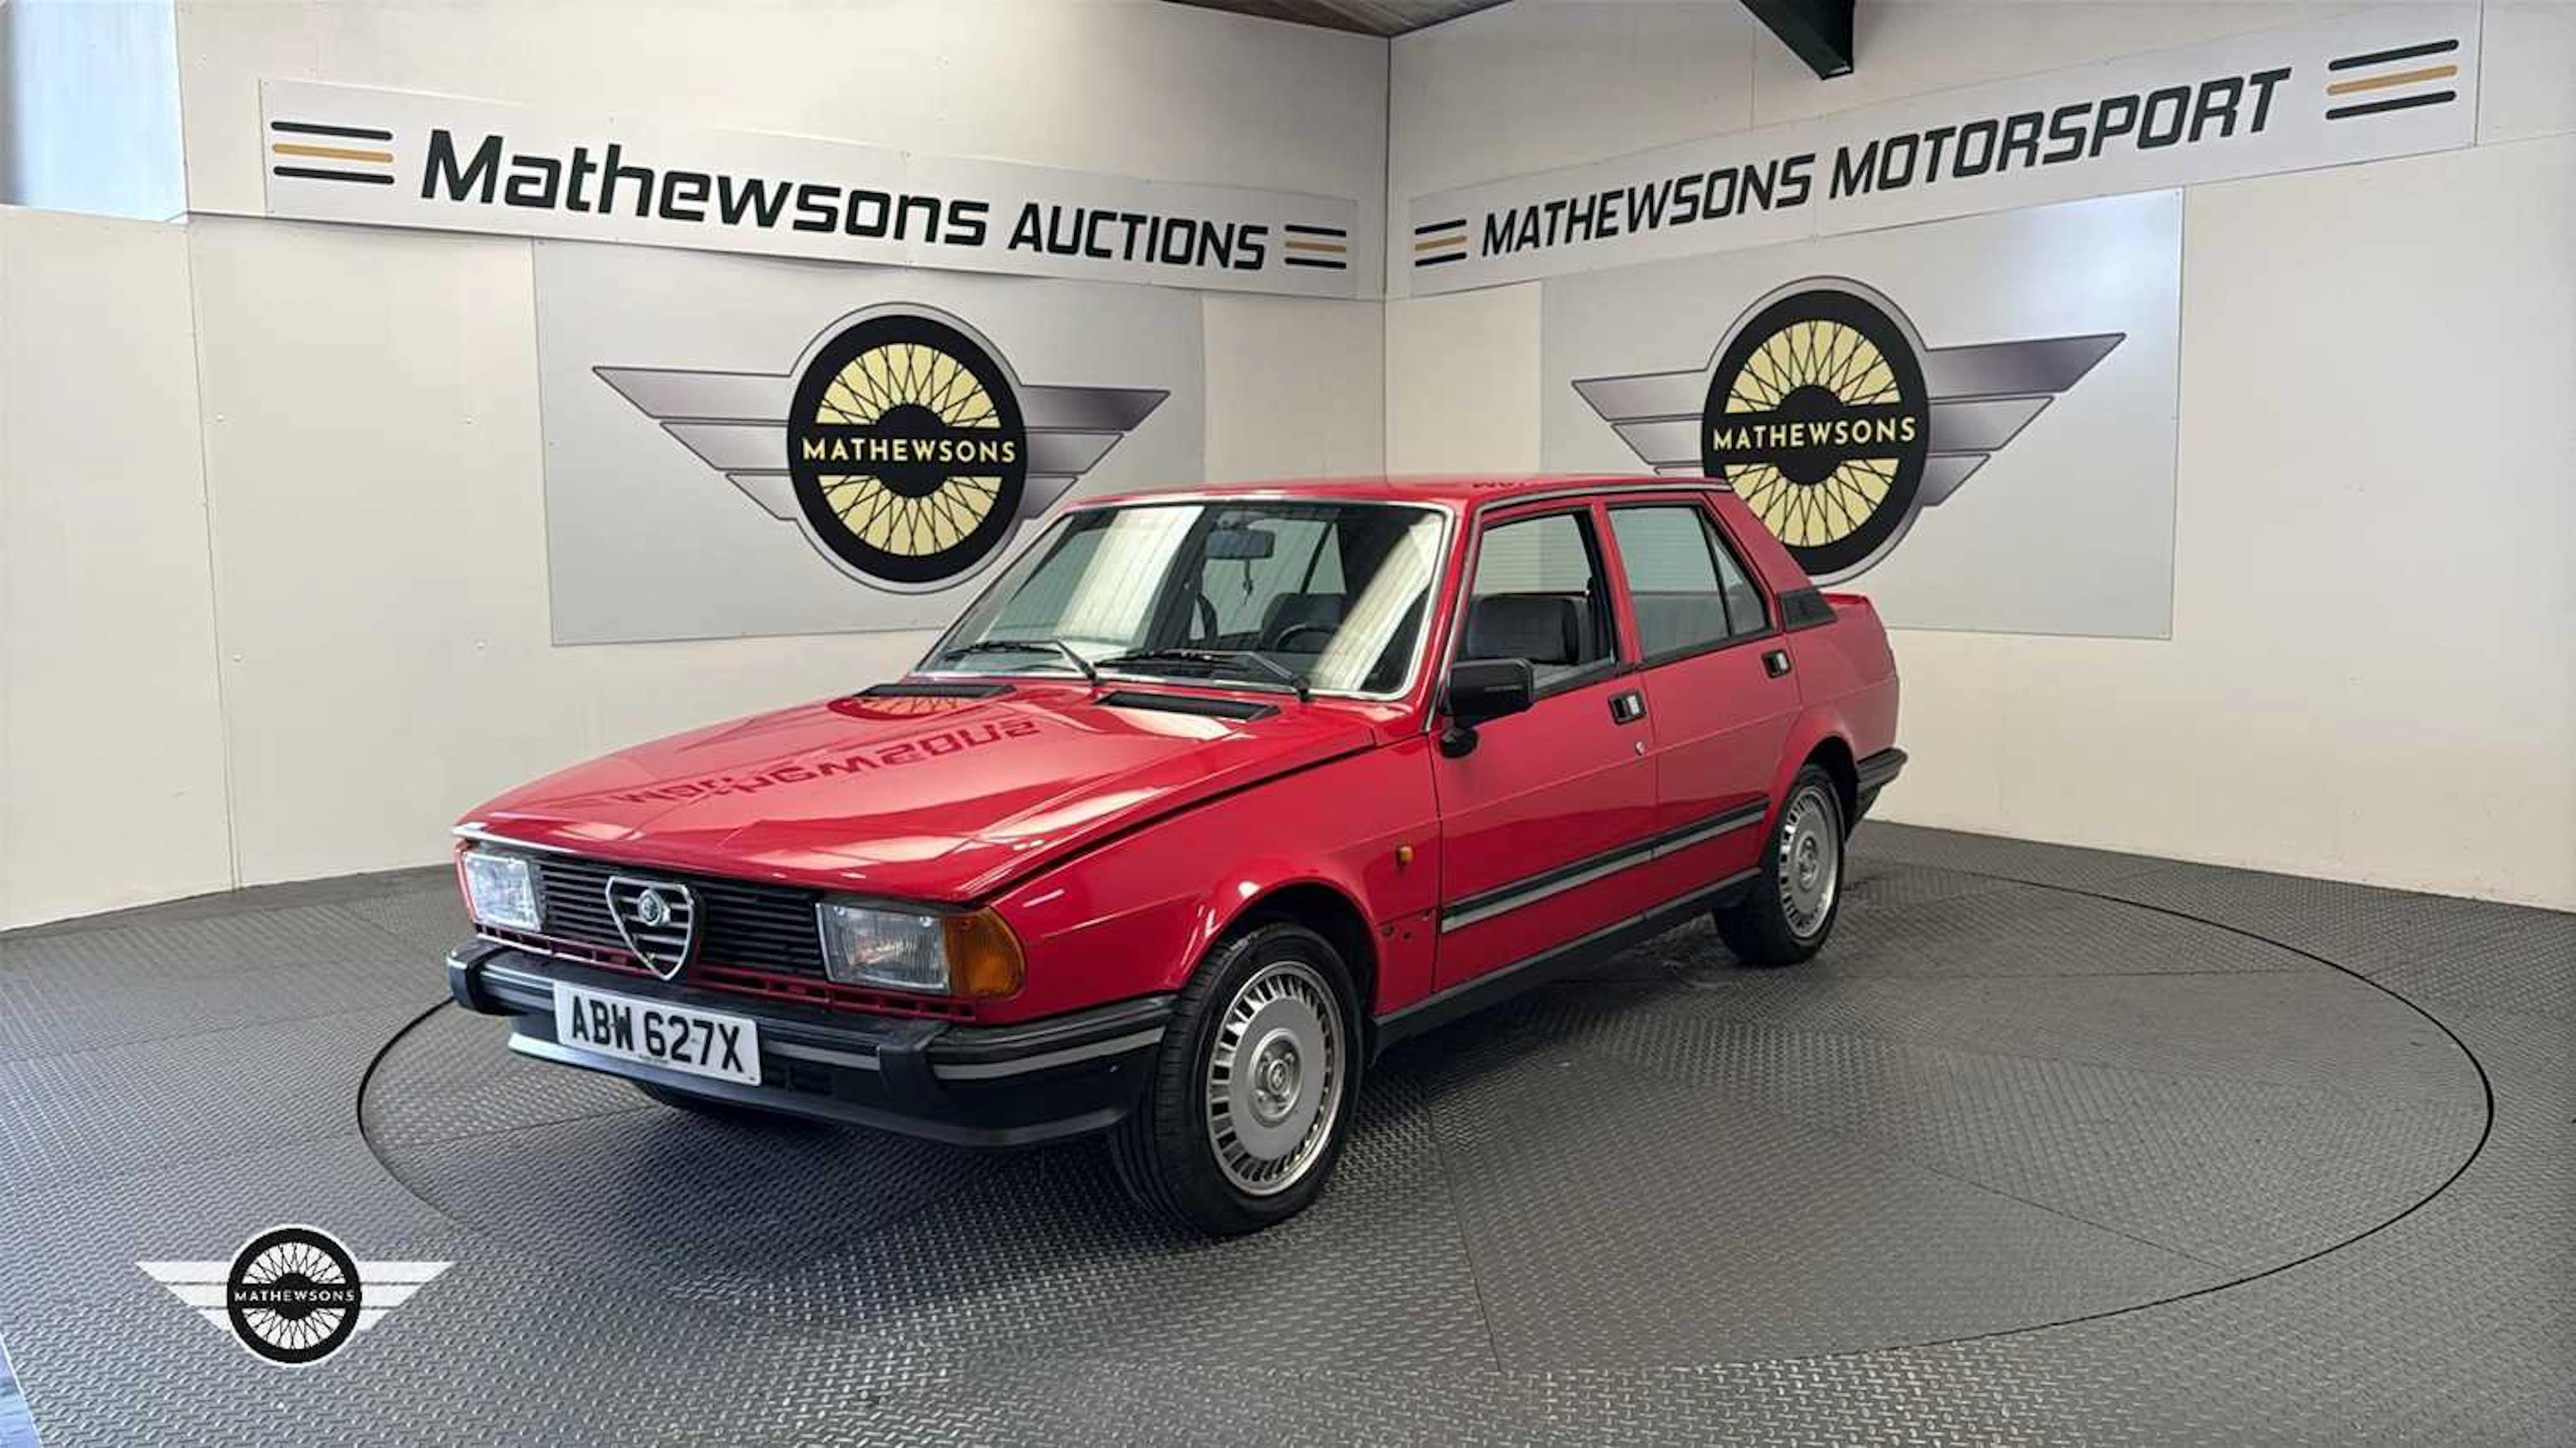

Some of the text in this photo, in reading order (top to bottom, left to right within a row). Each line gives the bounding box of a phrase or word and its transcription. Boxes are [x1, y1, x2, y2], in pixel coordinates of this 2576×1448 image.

[421, 129, 1269, 270] Mathewsons AUCTIONS
[1482, 67, 2292, 256] MATHEWSONS MOTORSPORT
[802, 437, 1016, 463] MATHEWSONS
[1713, 417, 1917, 450] MATHEWSONS
[572, 996, 743, 1072] ABW 627X
